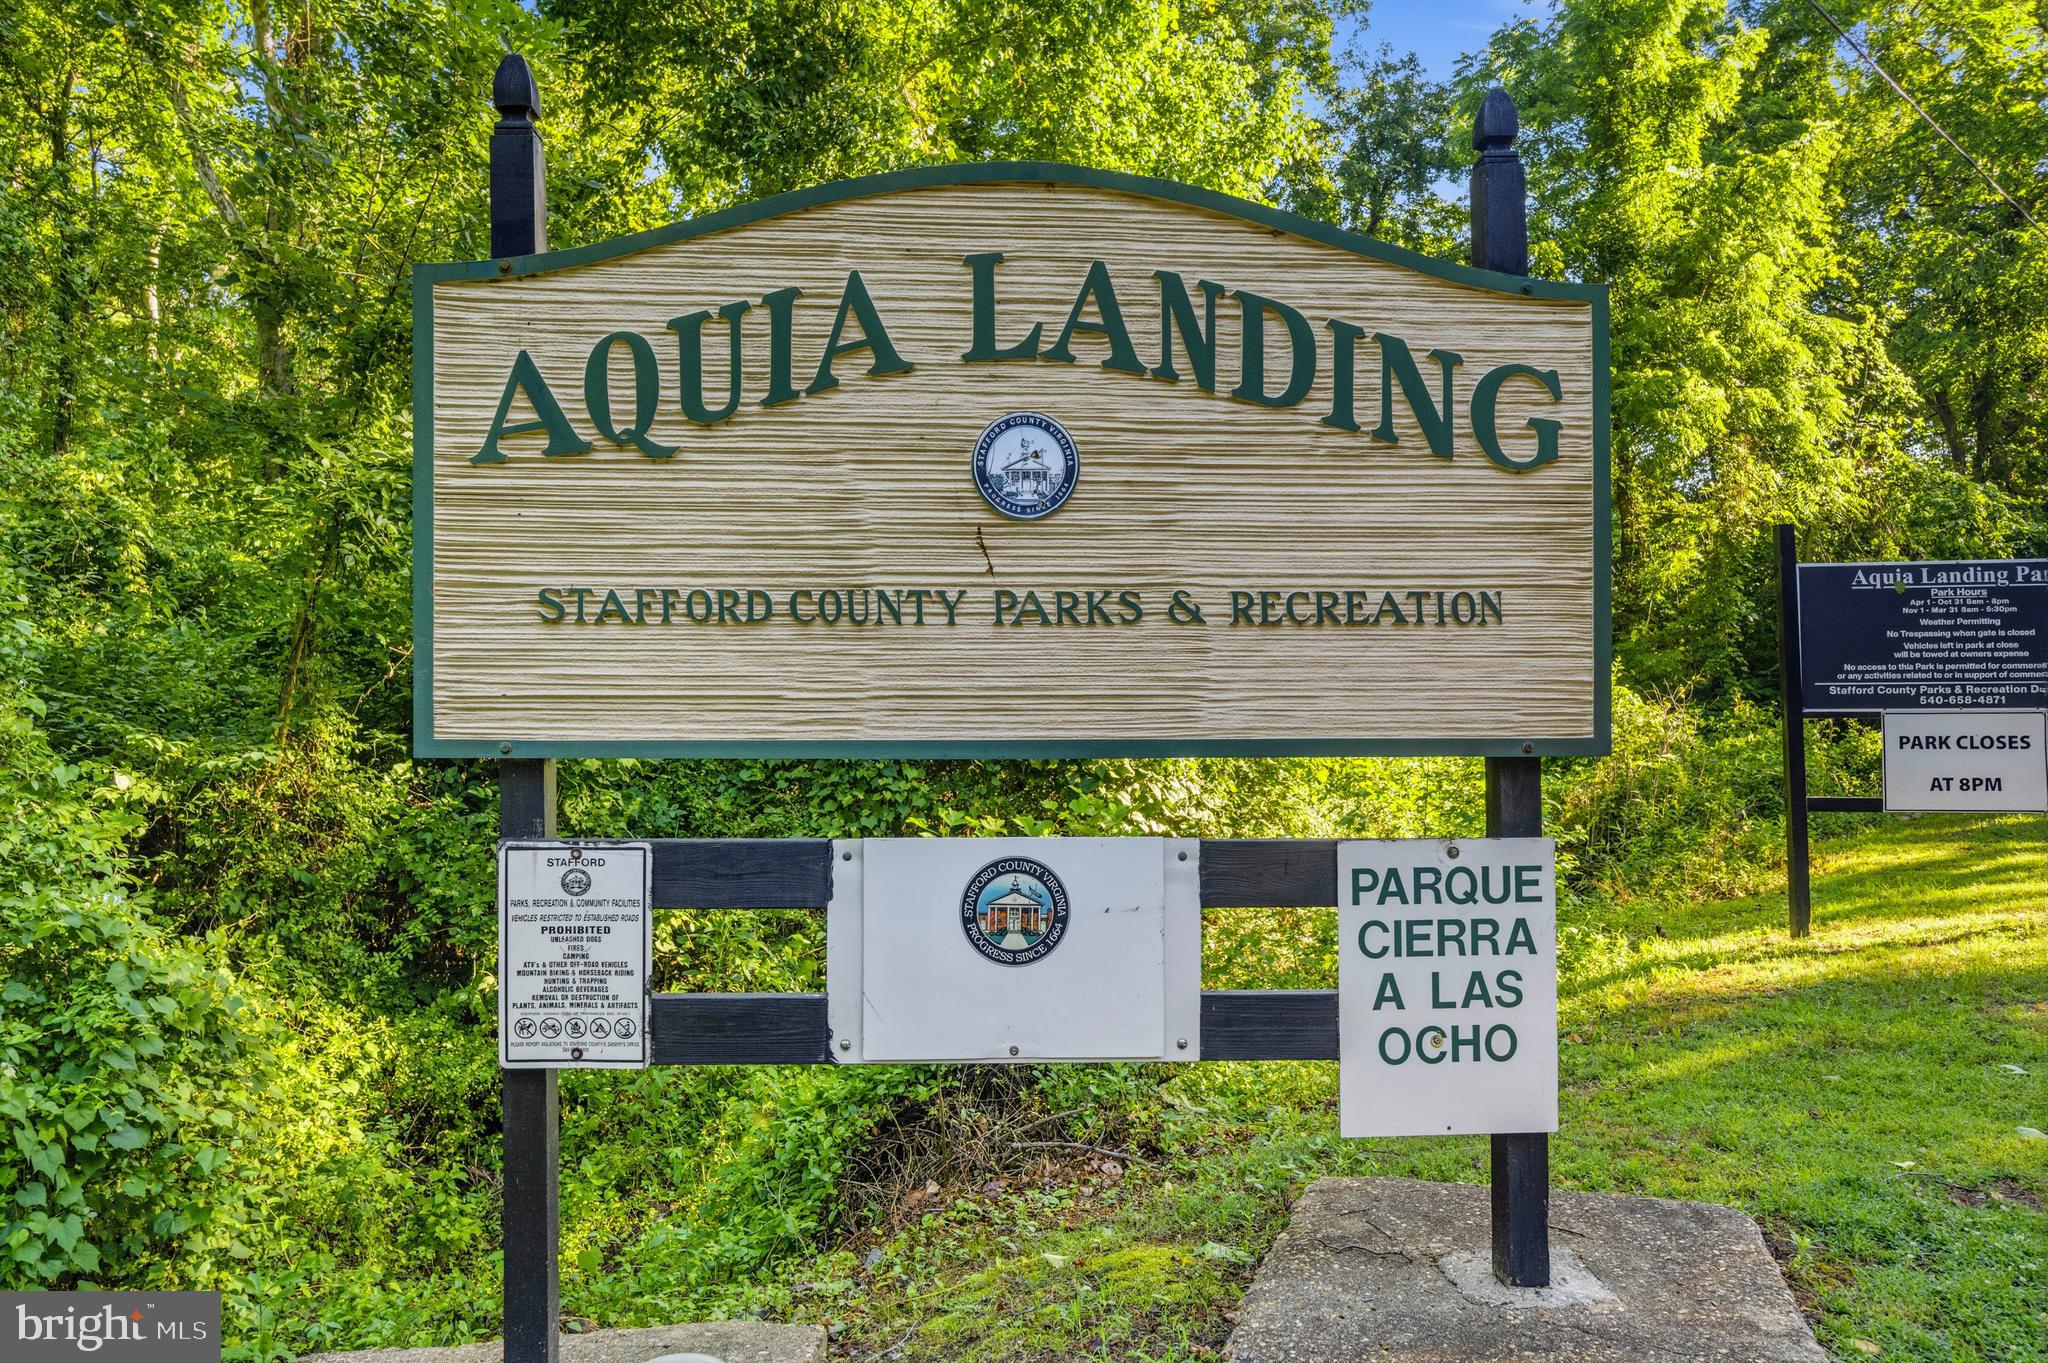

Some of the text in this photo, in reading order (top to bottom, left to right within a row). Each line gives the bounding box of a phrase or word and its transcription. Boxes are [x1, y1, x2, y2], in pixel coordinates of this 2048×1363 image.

[468, 252, 1564, 474] AQUIA LANDING
[977, 417, 1073, 466] STAFFORD COUNTY VIRGINIA
[984, 483, 1020, 512] PROGRESS
[1852, 569, 1913, 589] Aquia
[1921, 567, 2008, 586] Landing
[1957, 588, 1987, 596] Hours
[537, 587, 1503, 626] STAFFORD COUNTY PARKS & RECREATION
[1957, 618, 2000, 626] Permitting
[1901, 630, 1951, 638] Trespassing
[1829, 686, 1874, 694] Stafford
[1877, 686, 1916, 695] County
[1920, 686, 1951, 694] Parks
[1966, 685, 2027, 693] Recreation
[1920, 696, 2006, 704] 540-658-4871
[1899, 735, 2031, 750] PARK CLOSES
[1930, 778, 2002, 791] AT 8PM
[547, 858, 605, 867] STAFFORD
[964, 861, 1066, 917] STAFFORD COUNTY VIRGINIA
[1352, 865, 1542, 905] PARQUE
[511, 900, 530, 908] PARKS,
[540, 914, 573, 922] RESTRICTED
[584, 914, 619, 922] ESTABLISHED
[541, 926, 610, 934] PROHIBITED
[1358, 918, 1537, 958] CIERRA
[967, 923, 1063, 962] PROGRESS SINCE 1664
[1373, 970, 1523, 1010] A LAS
[1379, 1024, 1518, 1065] OCHO
